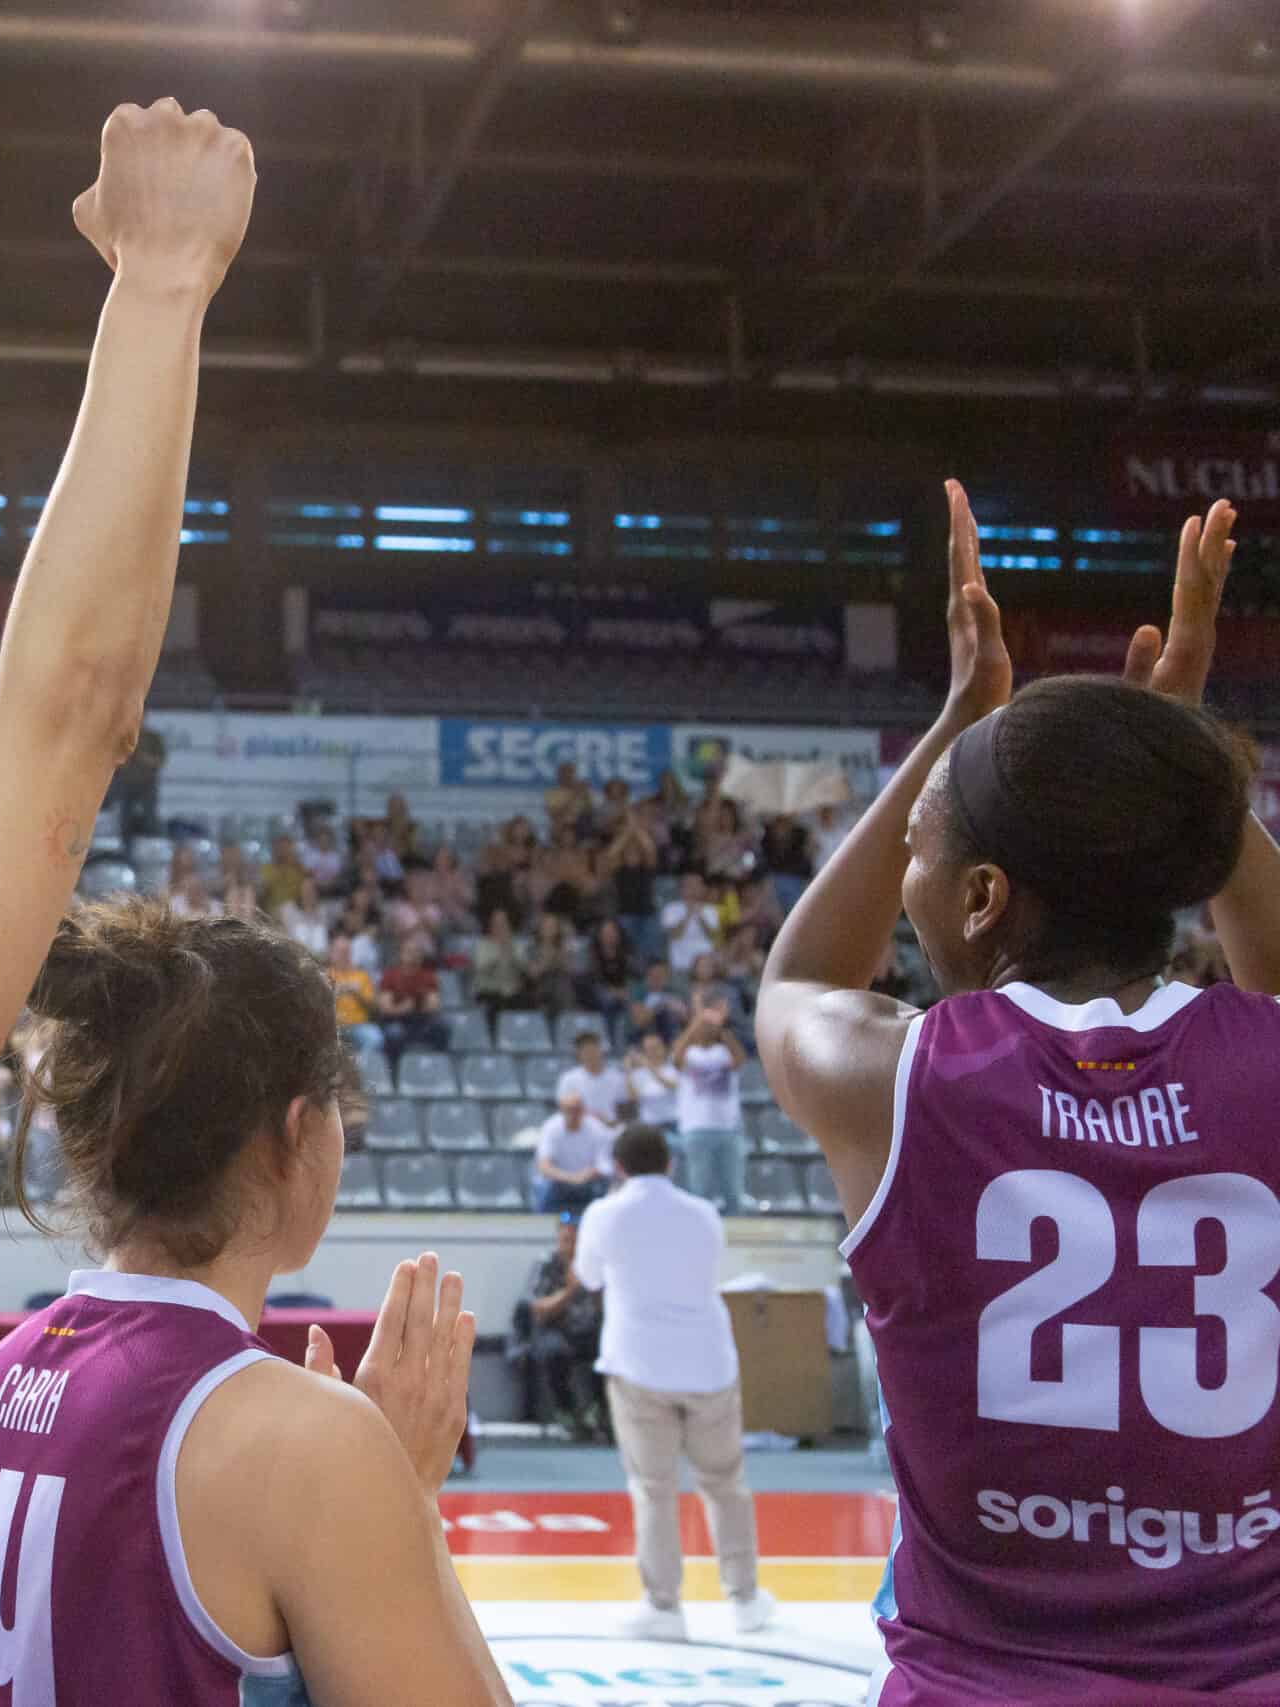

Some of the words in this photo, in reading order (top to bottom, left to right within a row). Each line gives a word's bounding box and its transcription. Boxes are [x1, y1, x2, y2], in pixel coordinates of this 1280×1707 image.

[462, 731, 649, 783] SEGRE
[1038, 1083, 1199, 1148] TRAORE
[976, 1168, 1280, 1438] 23
[976, 1485, 1280, 1569] sorigué
